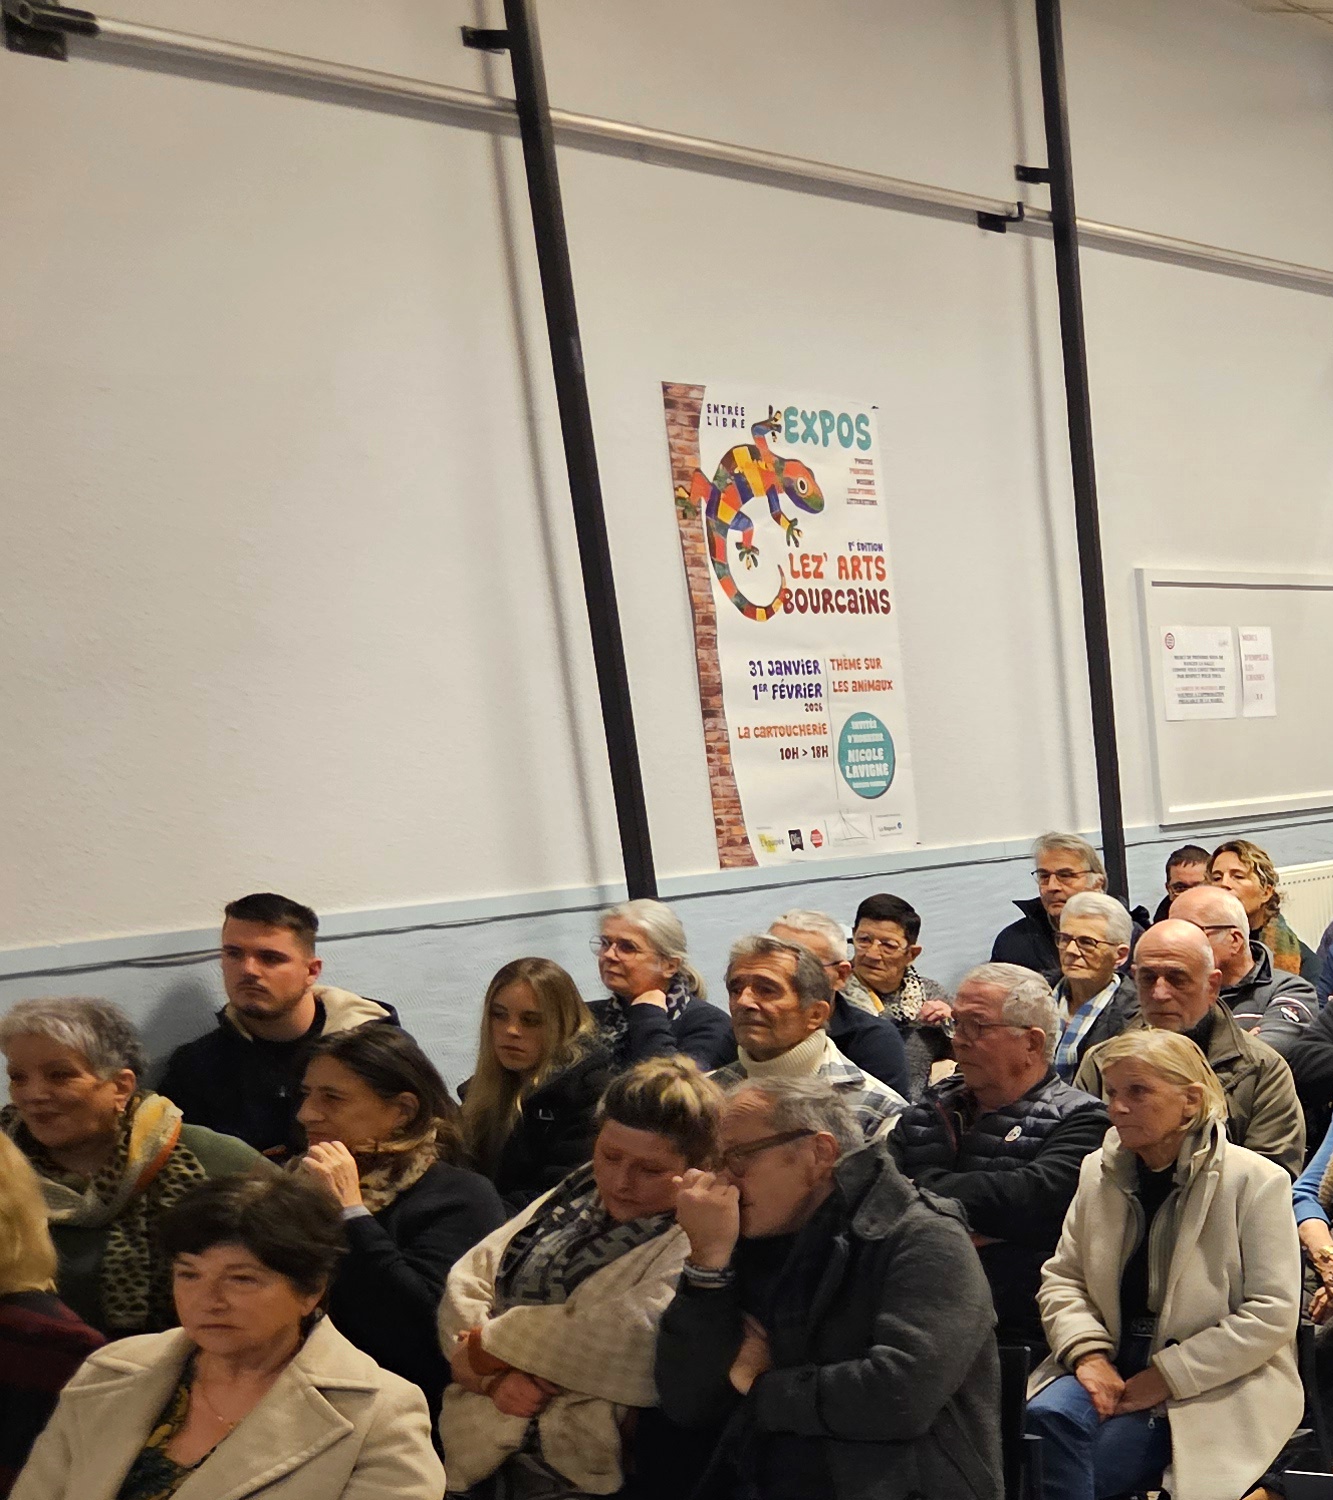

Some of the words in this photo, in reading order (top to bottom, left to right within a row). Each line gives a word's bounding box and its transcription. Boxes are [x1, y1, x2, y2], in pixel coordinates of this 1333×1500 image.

[706, 402, 745, 416] ENTRÉE
[783, 406, 872, 450] EXPOS
[837, 555, 886, 582] ARTS
[749, 660, 764, 677] 31
[830, 654, 862, 672] THÈME
[864, 657, 883, 670] SUR
[832, 681, 849, 693] LES
[804, 702, 823, 712] 2026
[779, 747, 799, 760] 10H
[811, 745, 829, 759] 18H
[848, 748, 884, 763] NICOLE
